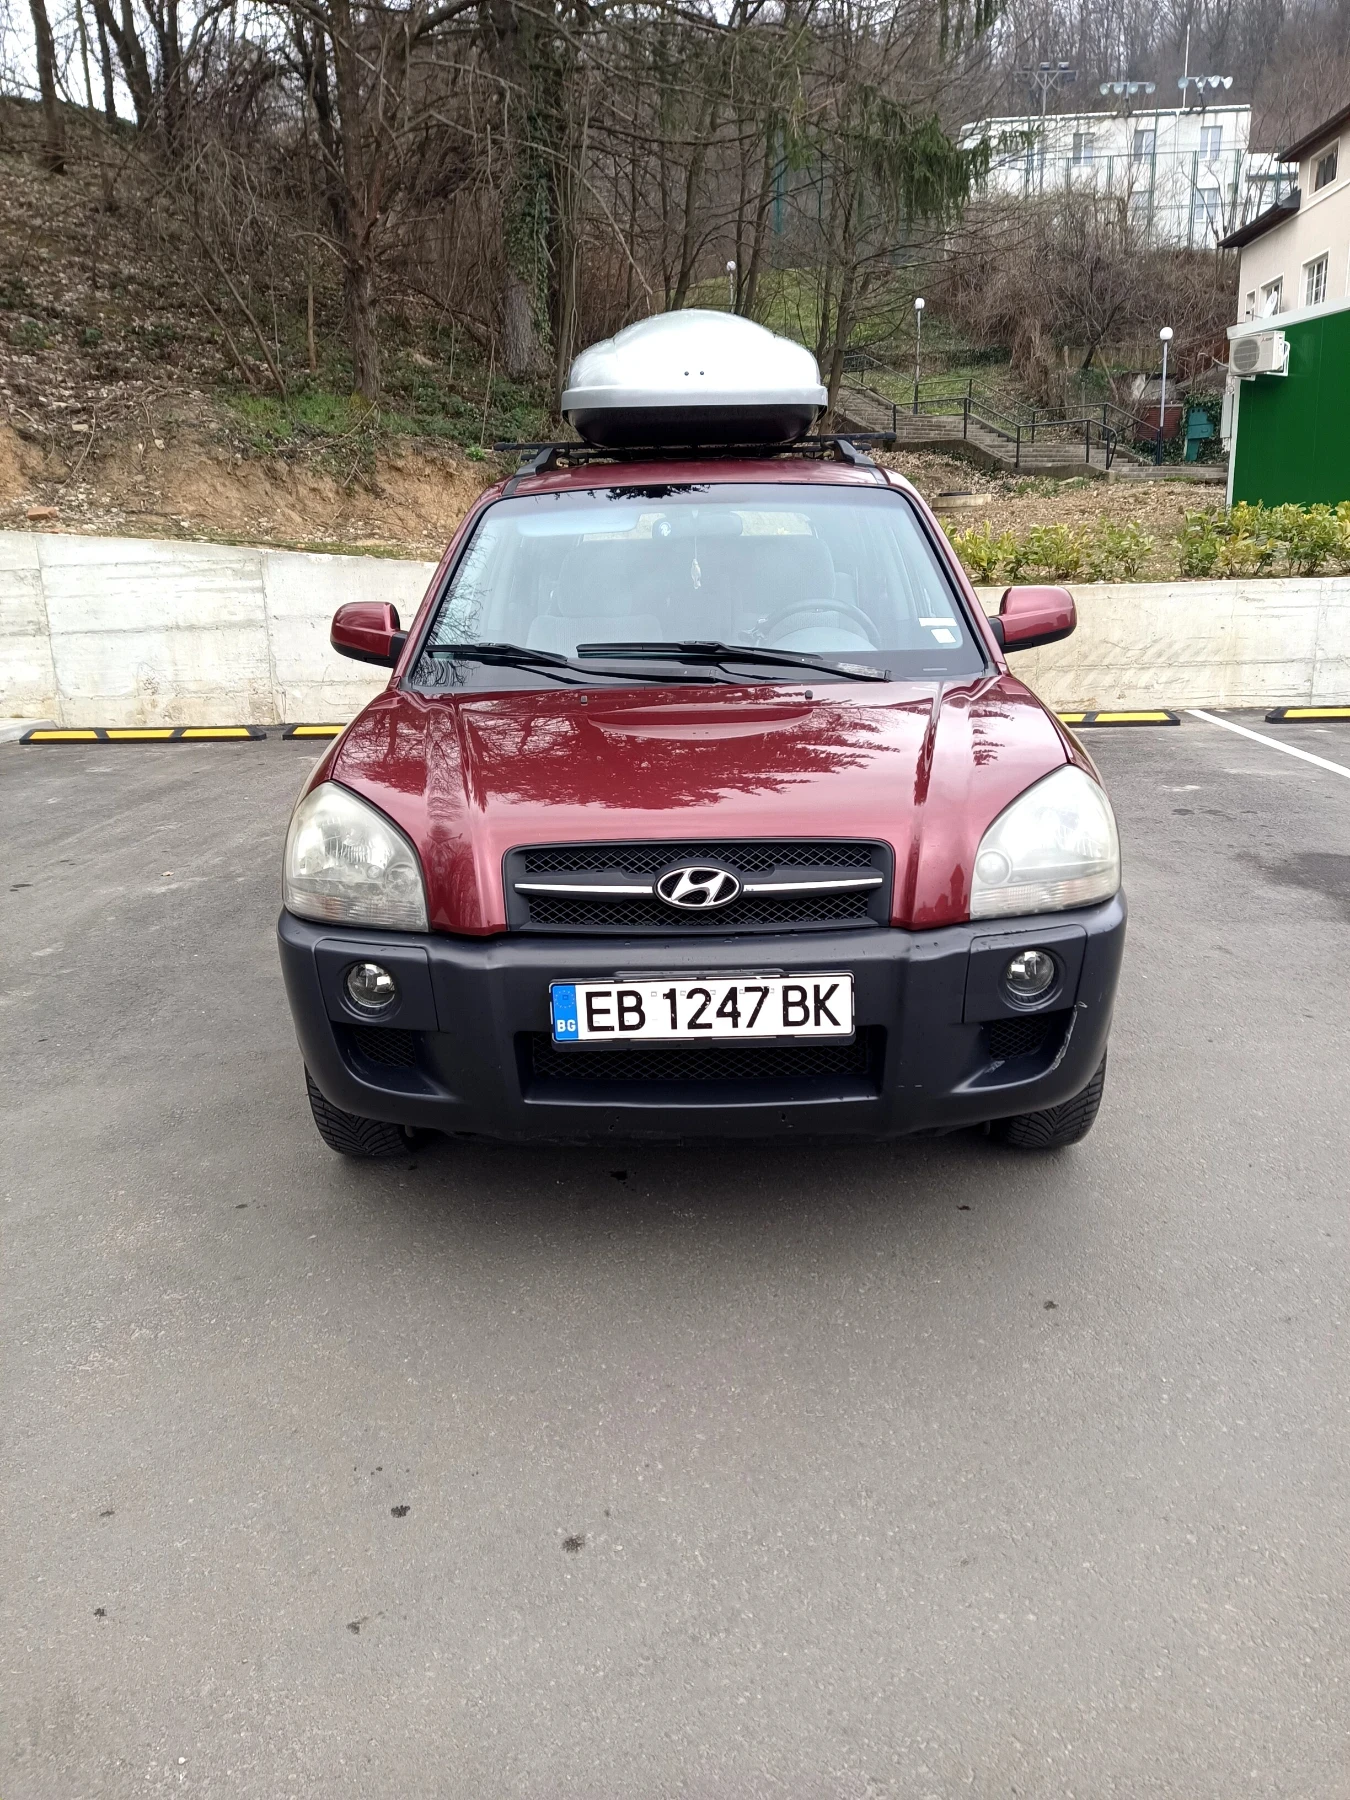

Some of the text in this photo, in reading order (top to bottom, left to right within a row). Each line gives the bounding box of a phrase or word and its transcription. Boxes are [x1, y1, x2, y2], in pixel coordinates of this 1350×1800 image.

[585, 983, 842, 1033] EB 1247 BK
[556, 1018, 577, 1033] BG
